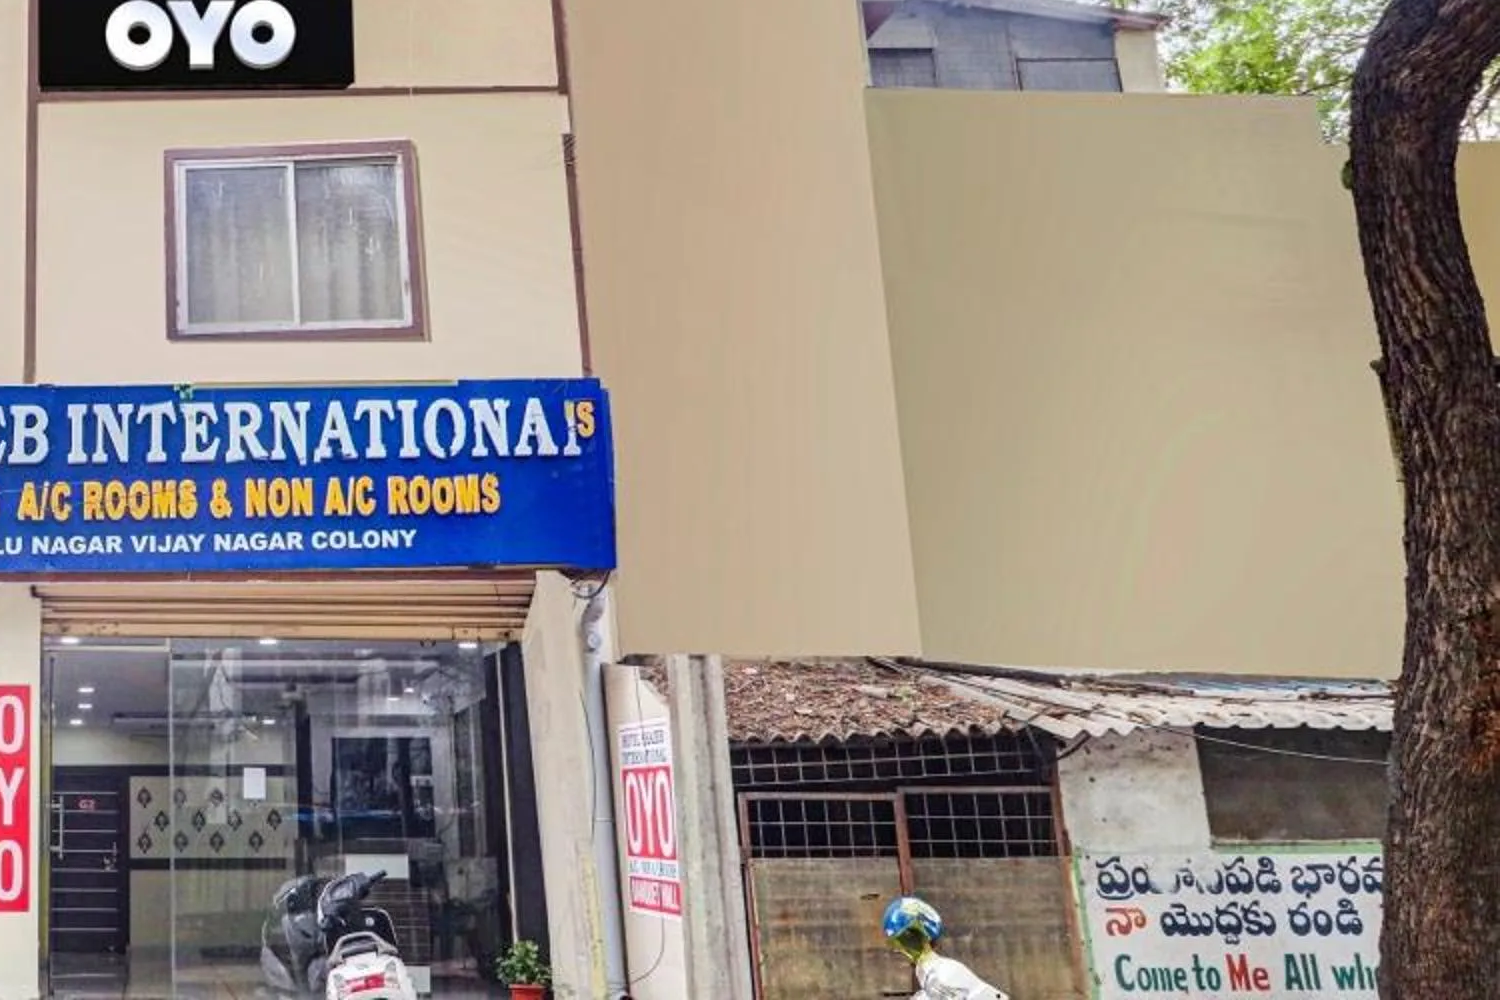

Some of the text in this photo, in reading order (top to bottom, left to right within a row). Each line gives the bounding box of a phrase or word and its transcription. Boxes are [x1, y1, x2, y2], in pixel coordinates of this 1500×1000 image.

[18, 480, 71, 521] A/C
[83, 478, 197, 520] ROOMS
[210, 478, 232, 518] &
[245, 477, 313, 517] NON
[324, 475, 375, 515] A/C
[388, 473, 500, 513] ROOMS
[32, 536, 122, 555] NAGAR
[131, 534, 204, 553] VIJAY
[214, 532, 302, 551] NAGAR
[311, 529, 416, 549] COLONY
[626, 770, 674, 858] OYO
[1115, 952, 1380, 994] Come to Me All wh
